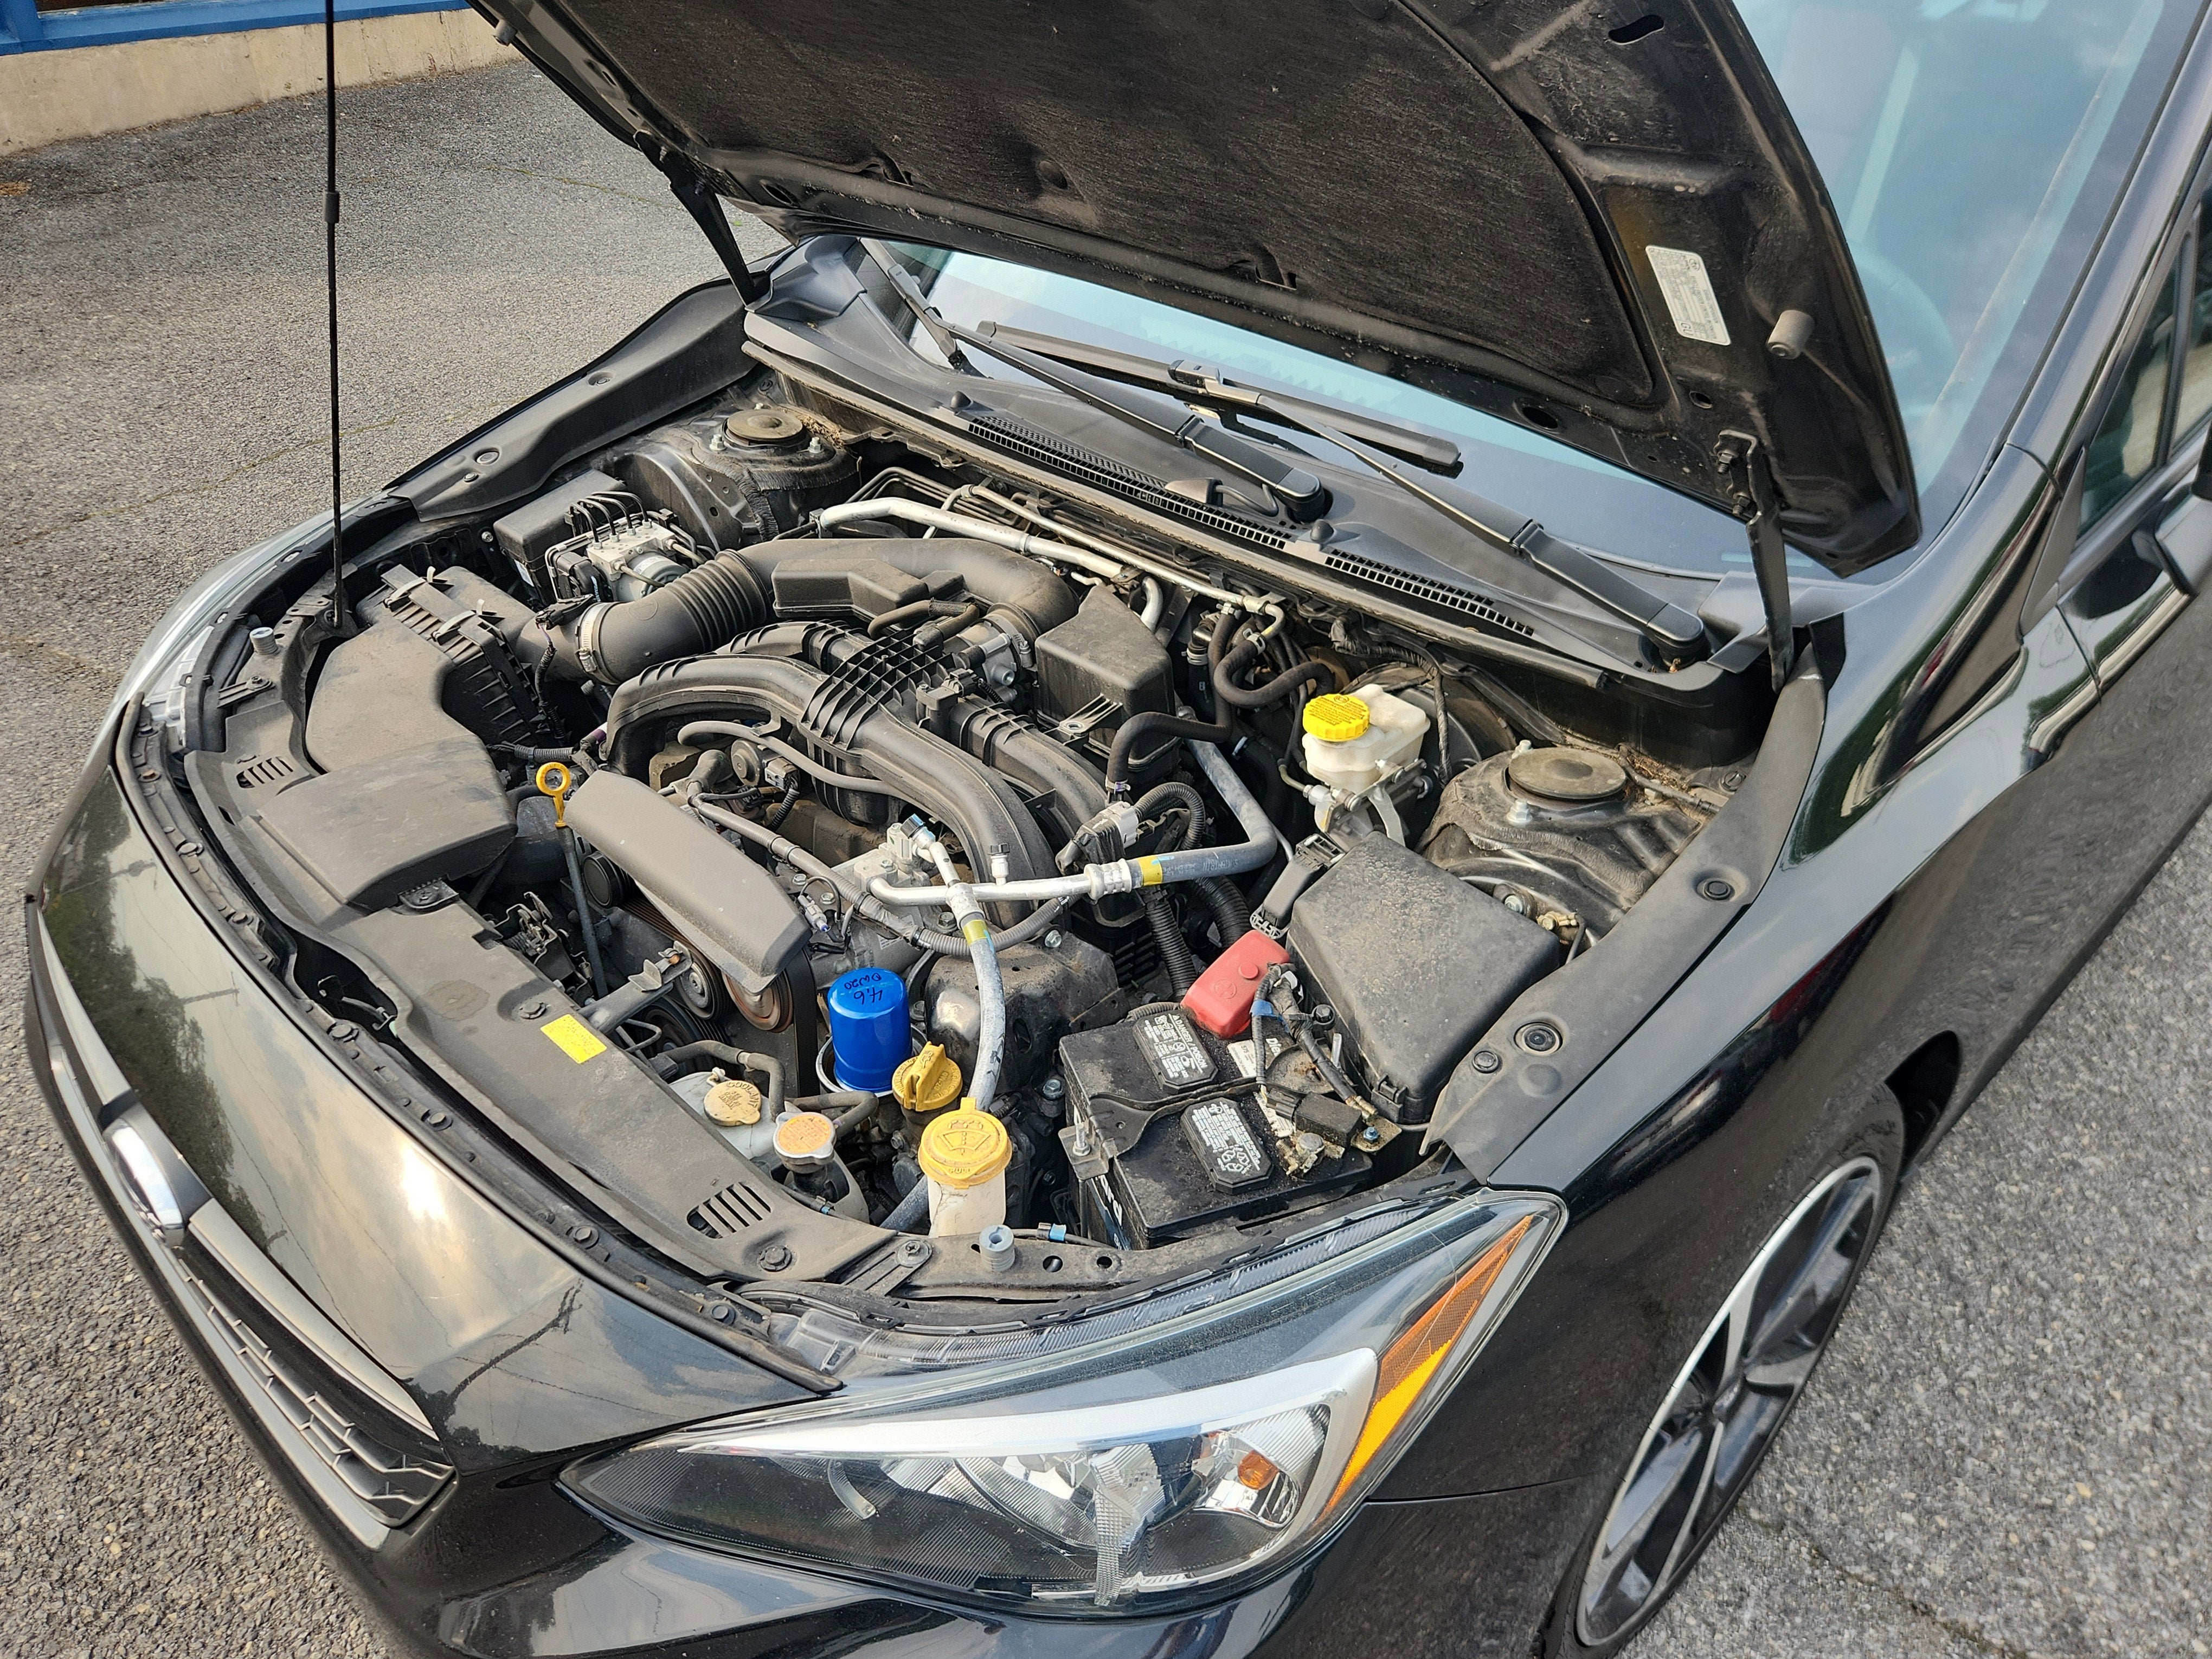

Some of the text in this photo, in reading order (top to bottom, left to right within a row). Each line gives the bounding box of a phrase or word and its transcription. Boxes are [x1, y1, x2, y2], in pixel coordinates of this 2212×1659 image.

[1175, 1020, 1193, 1043] DANGER
[1190, 1047, 1208, 1069] POISON
[727, 1082, 759, 1108] COOLANT
